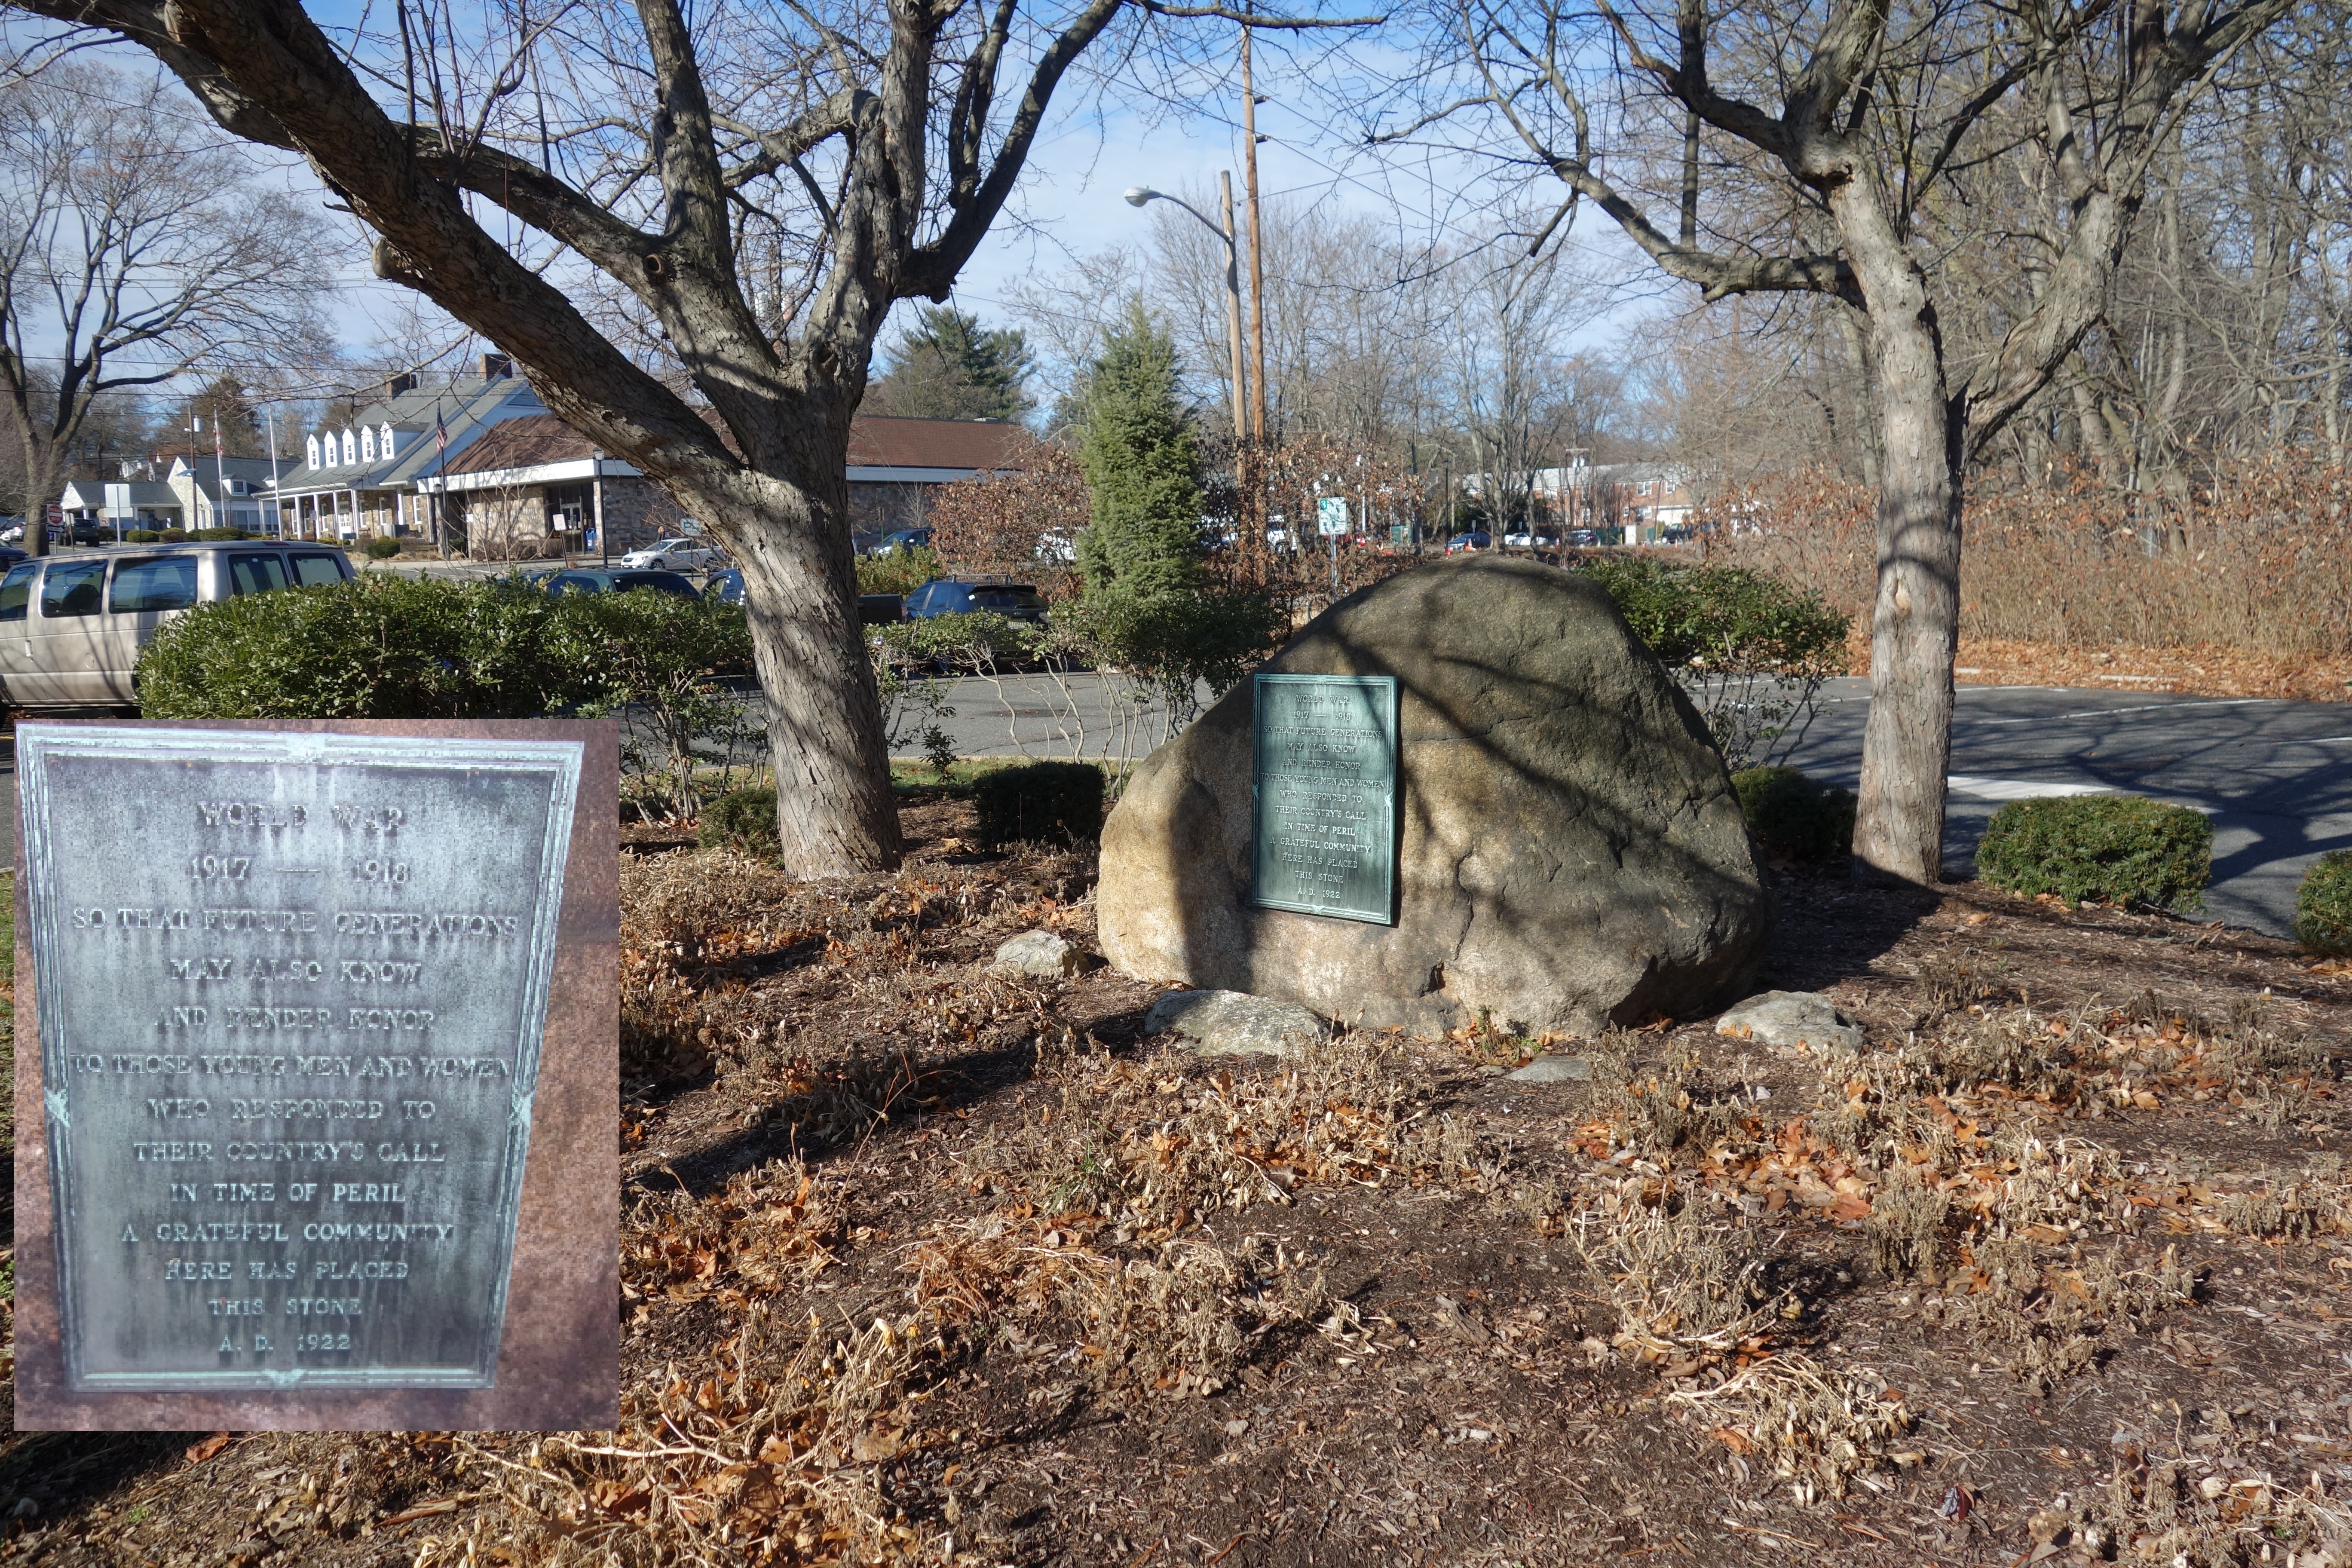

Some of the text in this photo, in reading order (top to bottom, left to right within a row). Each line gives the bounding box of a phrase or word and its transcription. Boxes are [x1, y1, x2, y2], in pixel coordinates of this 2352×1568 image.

[1329, 695, 1349, 704] WAR
[1335, 713, 1351, 721] 1918
[1296, 727, 1326, 736] FUTURE
[1331, 729, 1383, 738] GENERATIONS
[1308, 744, 1328, 752] ALSO
[1332, 744, 1356, 753] KNOW
[1302, 760, 1331, 768] RENDER
[1335, 761, 1361, 770] HONOR
[1271, 774, 1292, 782] THOSE
[1294, 775, 1318, 784] YOUNG
[1321, 777, 1337, 785] MEN
[1357, 779, 1384, 788] WOMEN
[1280, 790, 1297, 798] WHO
[1303, 792, 1346, 802] RESPONDED
[1275, 805, 1367, 820] THEIR COUNTRY'S CALL
[1297, 823, 1316, 832] TIME
[1332, 827, 1355, 836] PERIL
[1280, 838, 1320, 848] GRATEFUL
[1324, 842, 1371, 853] COMMUNITY
[1282, 852, 1303, 862] HERE
[1328, 858, 1357, 868] PLACED
[1295, 870, 1344, 883] THIS STONE
[1323, 890, 1340, 898] 1922
